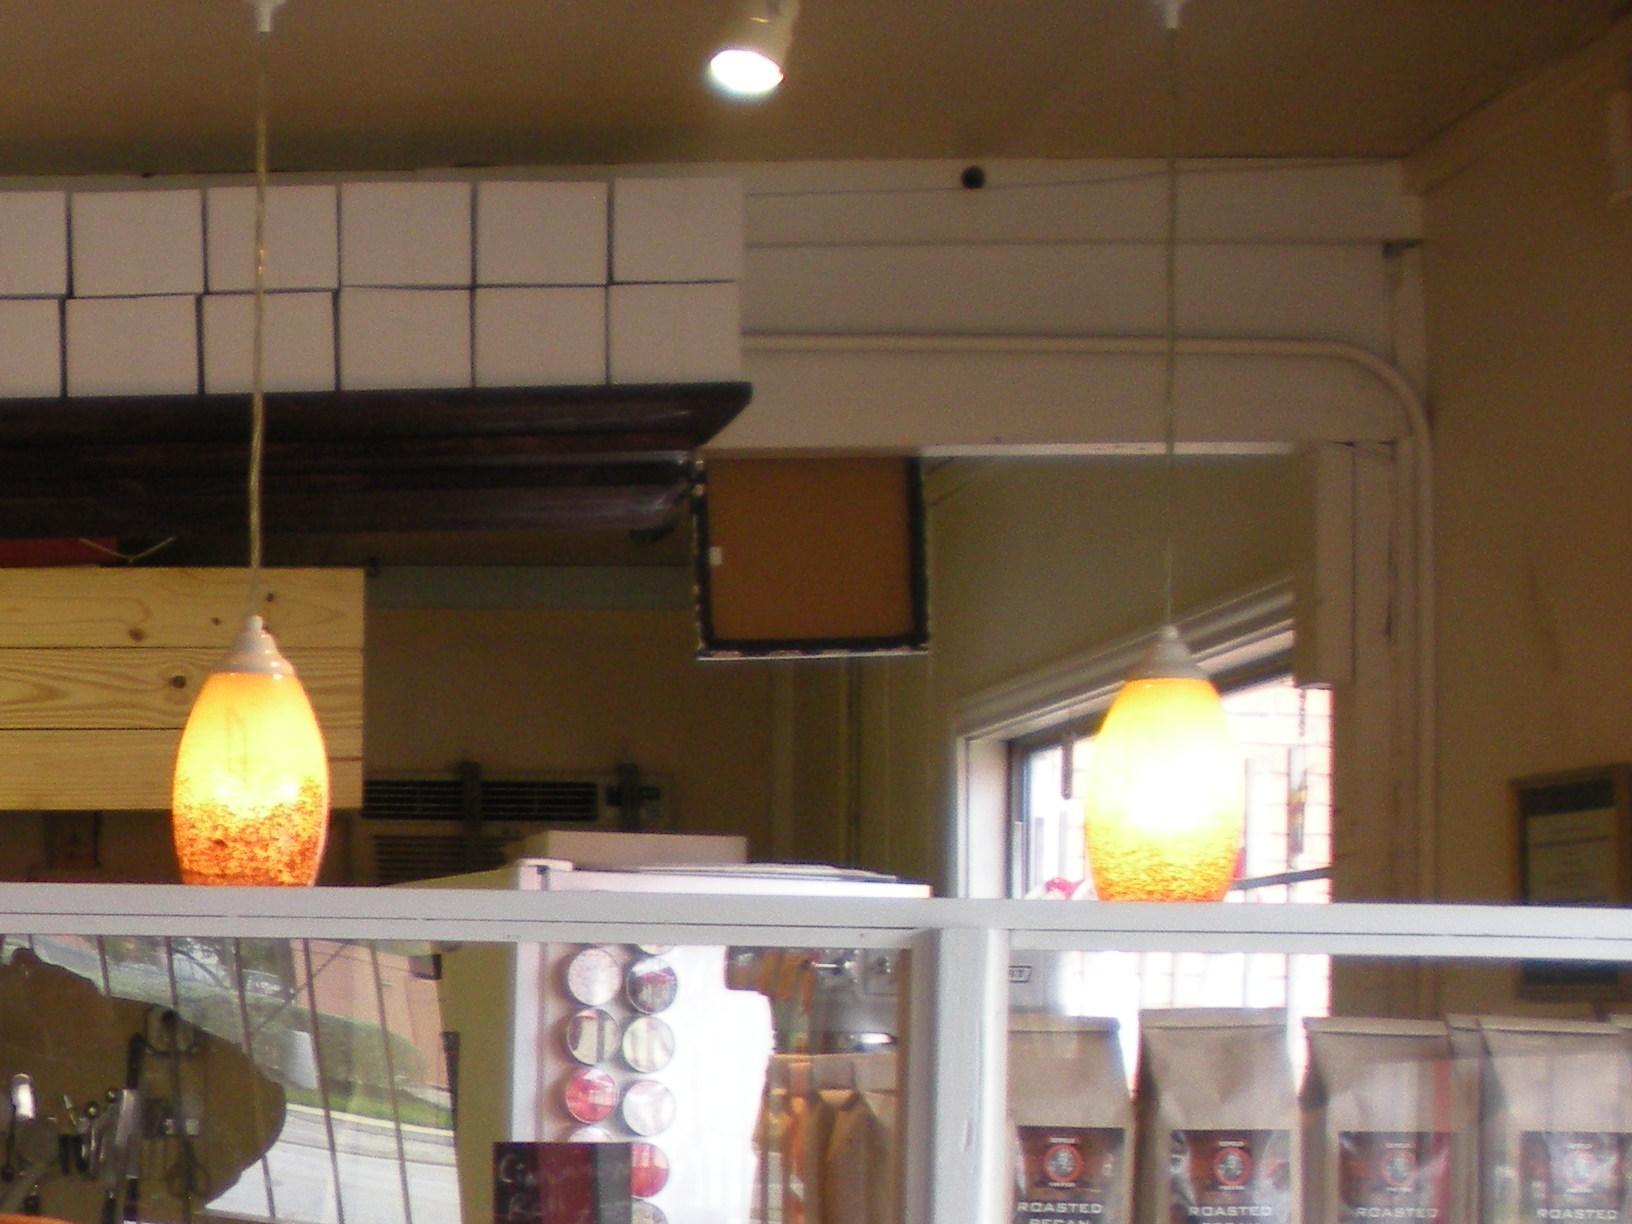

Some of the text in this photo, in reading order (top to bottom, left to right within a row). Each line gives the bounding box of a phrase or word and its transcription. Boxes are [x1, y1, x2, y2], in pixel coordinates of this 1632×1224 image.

[1017, 1201, 1105, 1214] ROASTED
[1188, 1205, 1273, 1218] ROASTED
[1355, 1207, 1440, 1219] ROASTED
[1536, 1208, 1620, 1220] ROASTED
